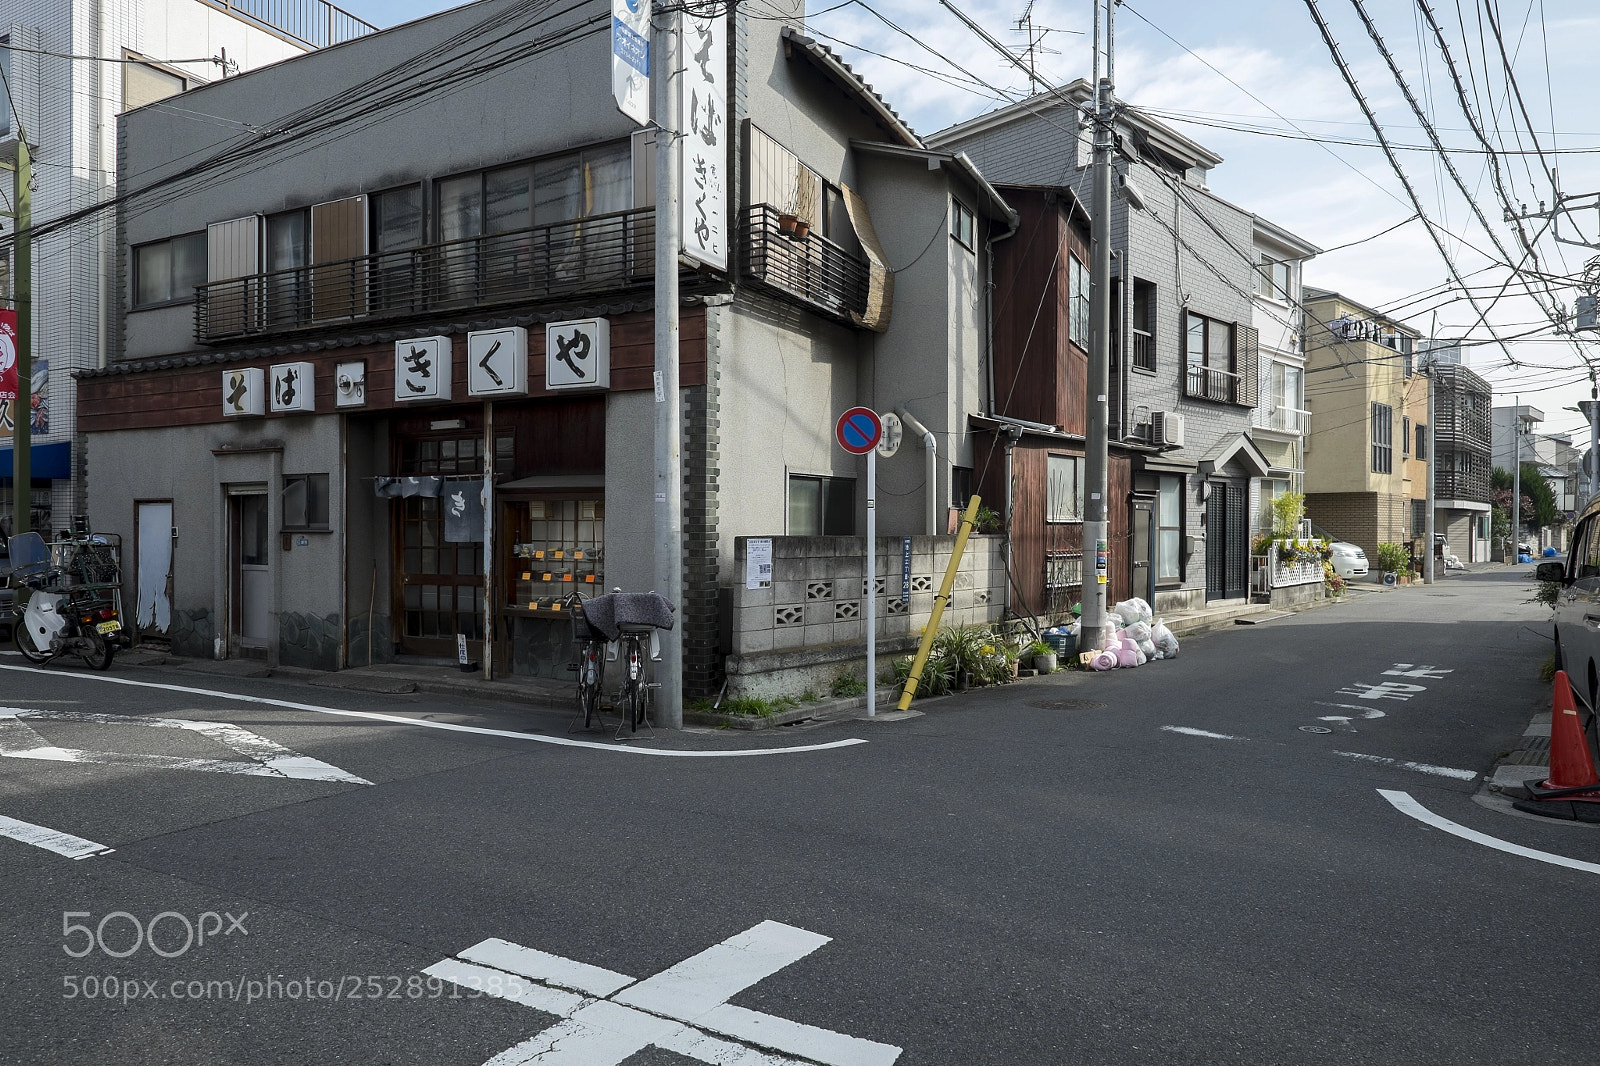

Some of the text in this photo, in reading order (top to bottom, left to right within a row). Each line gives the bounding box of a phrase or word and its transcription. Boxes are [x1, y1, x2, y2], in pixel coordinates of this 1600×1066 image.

[226, 367, 299, 411] そば
[403, 329, 592, 393] きくや
